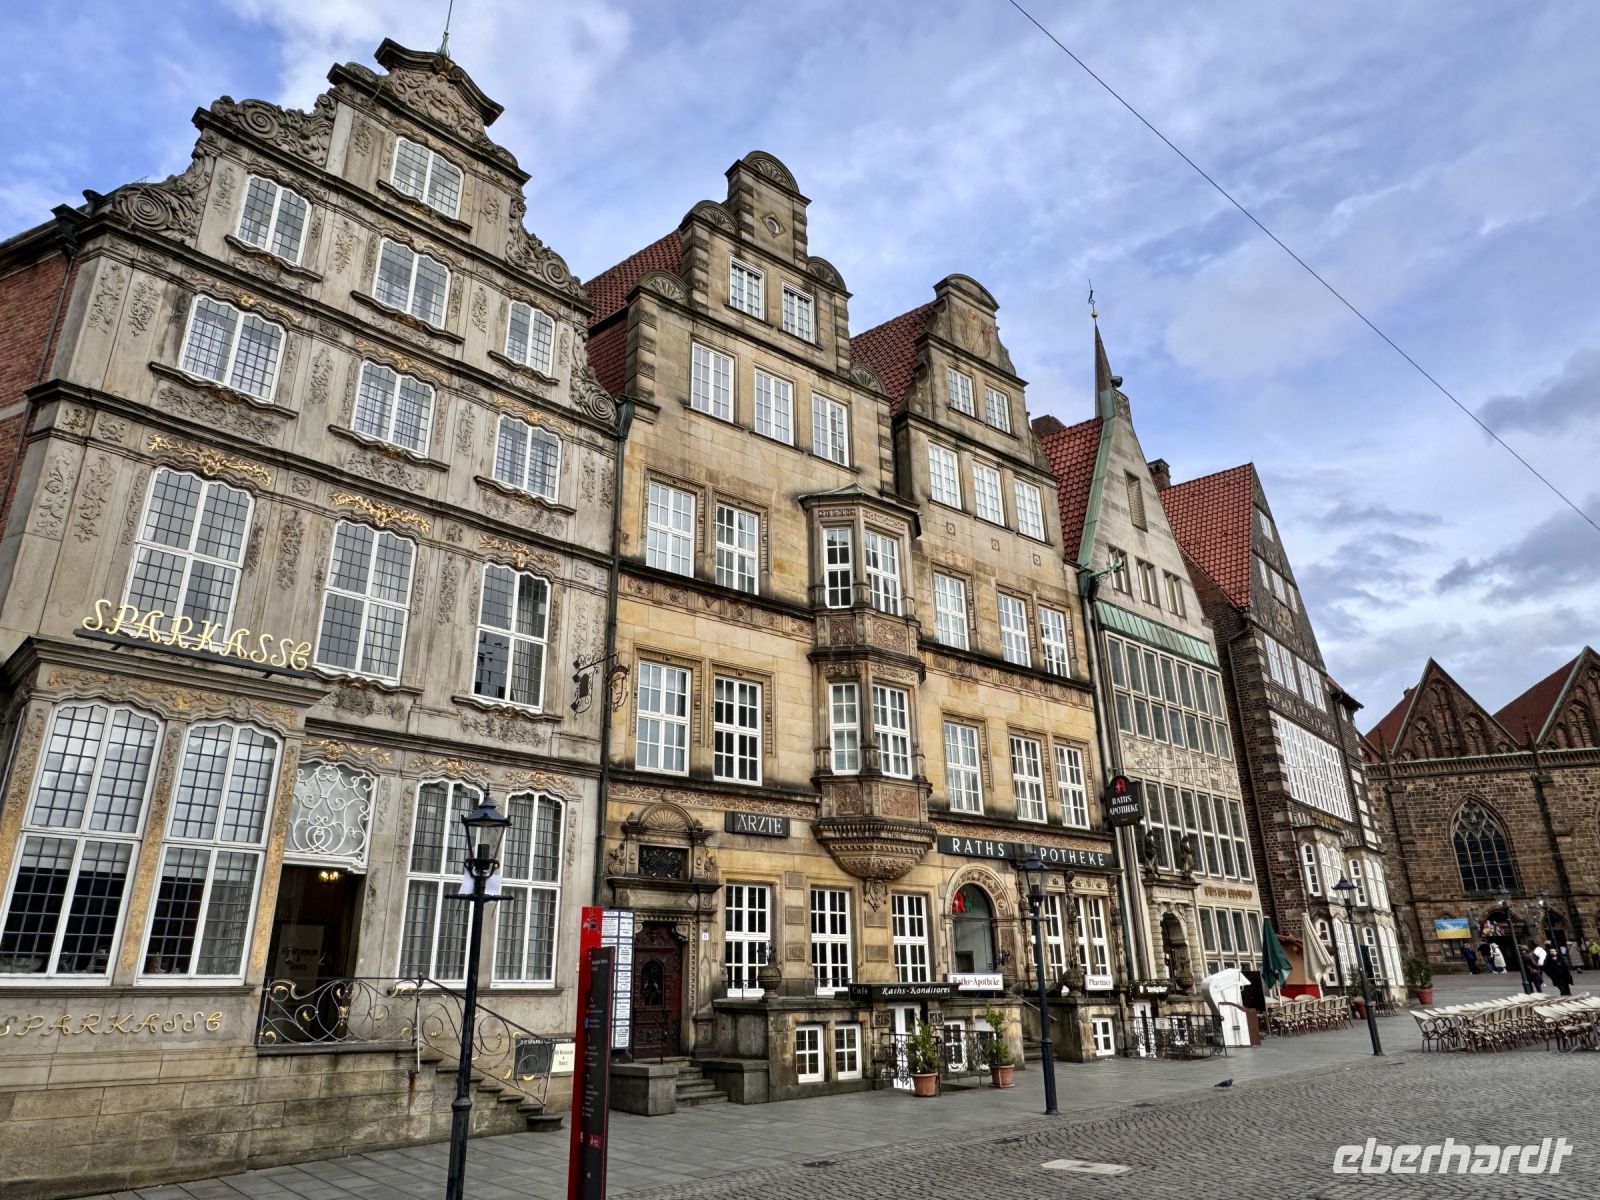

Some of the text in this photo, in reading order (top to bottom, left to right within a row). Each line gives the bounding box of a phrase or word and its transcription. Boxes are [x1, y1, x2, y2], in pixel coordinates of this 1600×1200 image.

[82, 599, 312, 671] SPARKASSE
[737, 813, 783, 834] ÄRZTE
[952, 837, 1105, 867] RATHS POTHEKE
